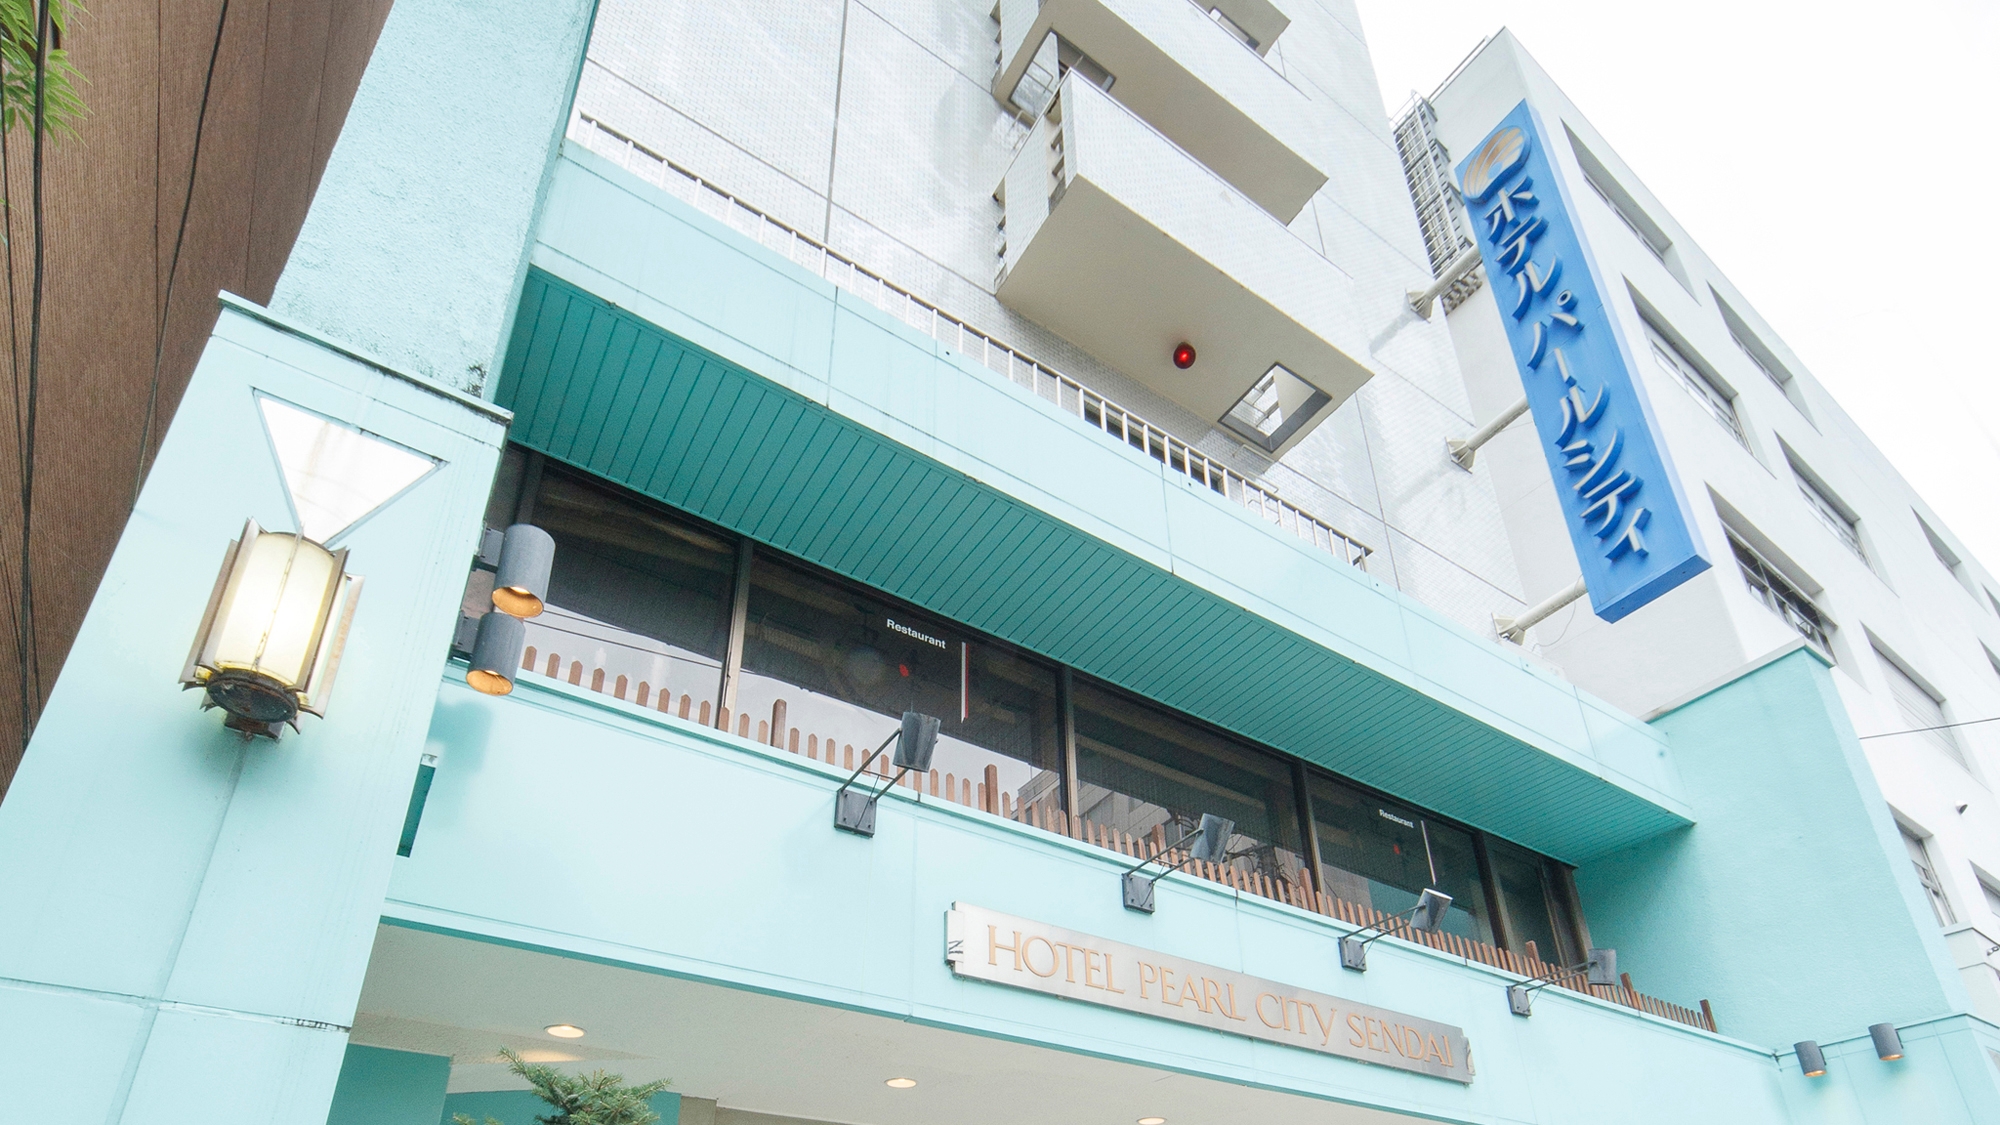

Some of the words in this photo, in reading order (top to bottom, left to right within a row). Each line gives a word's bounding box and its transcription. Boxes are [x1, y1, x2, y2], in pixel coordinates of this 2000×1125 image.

[1485, 174, 1649, 561] ホテルパールシティ
[886, 618, 946, 649] Restaurant
[1379, 808, 1414, 828] Restaurant
[987, 924, 1125, 994] HOTEL
[1137, 961, 1246, 1022] PEARL
[1256, 992, 1337, 1046] CITY
[1347, 1012, 1455, 1068] SENDAI
